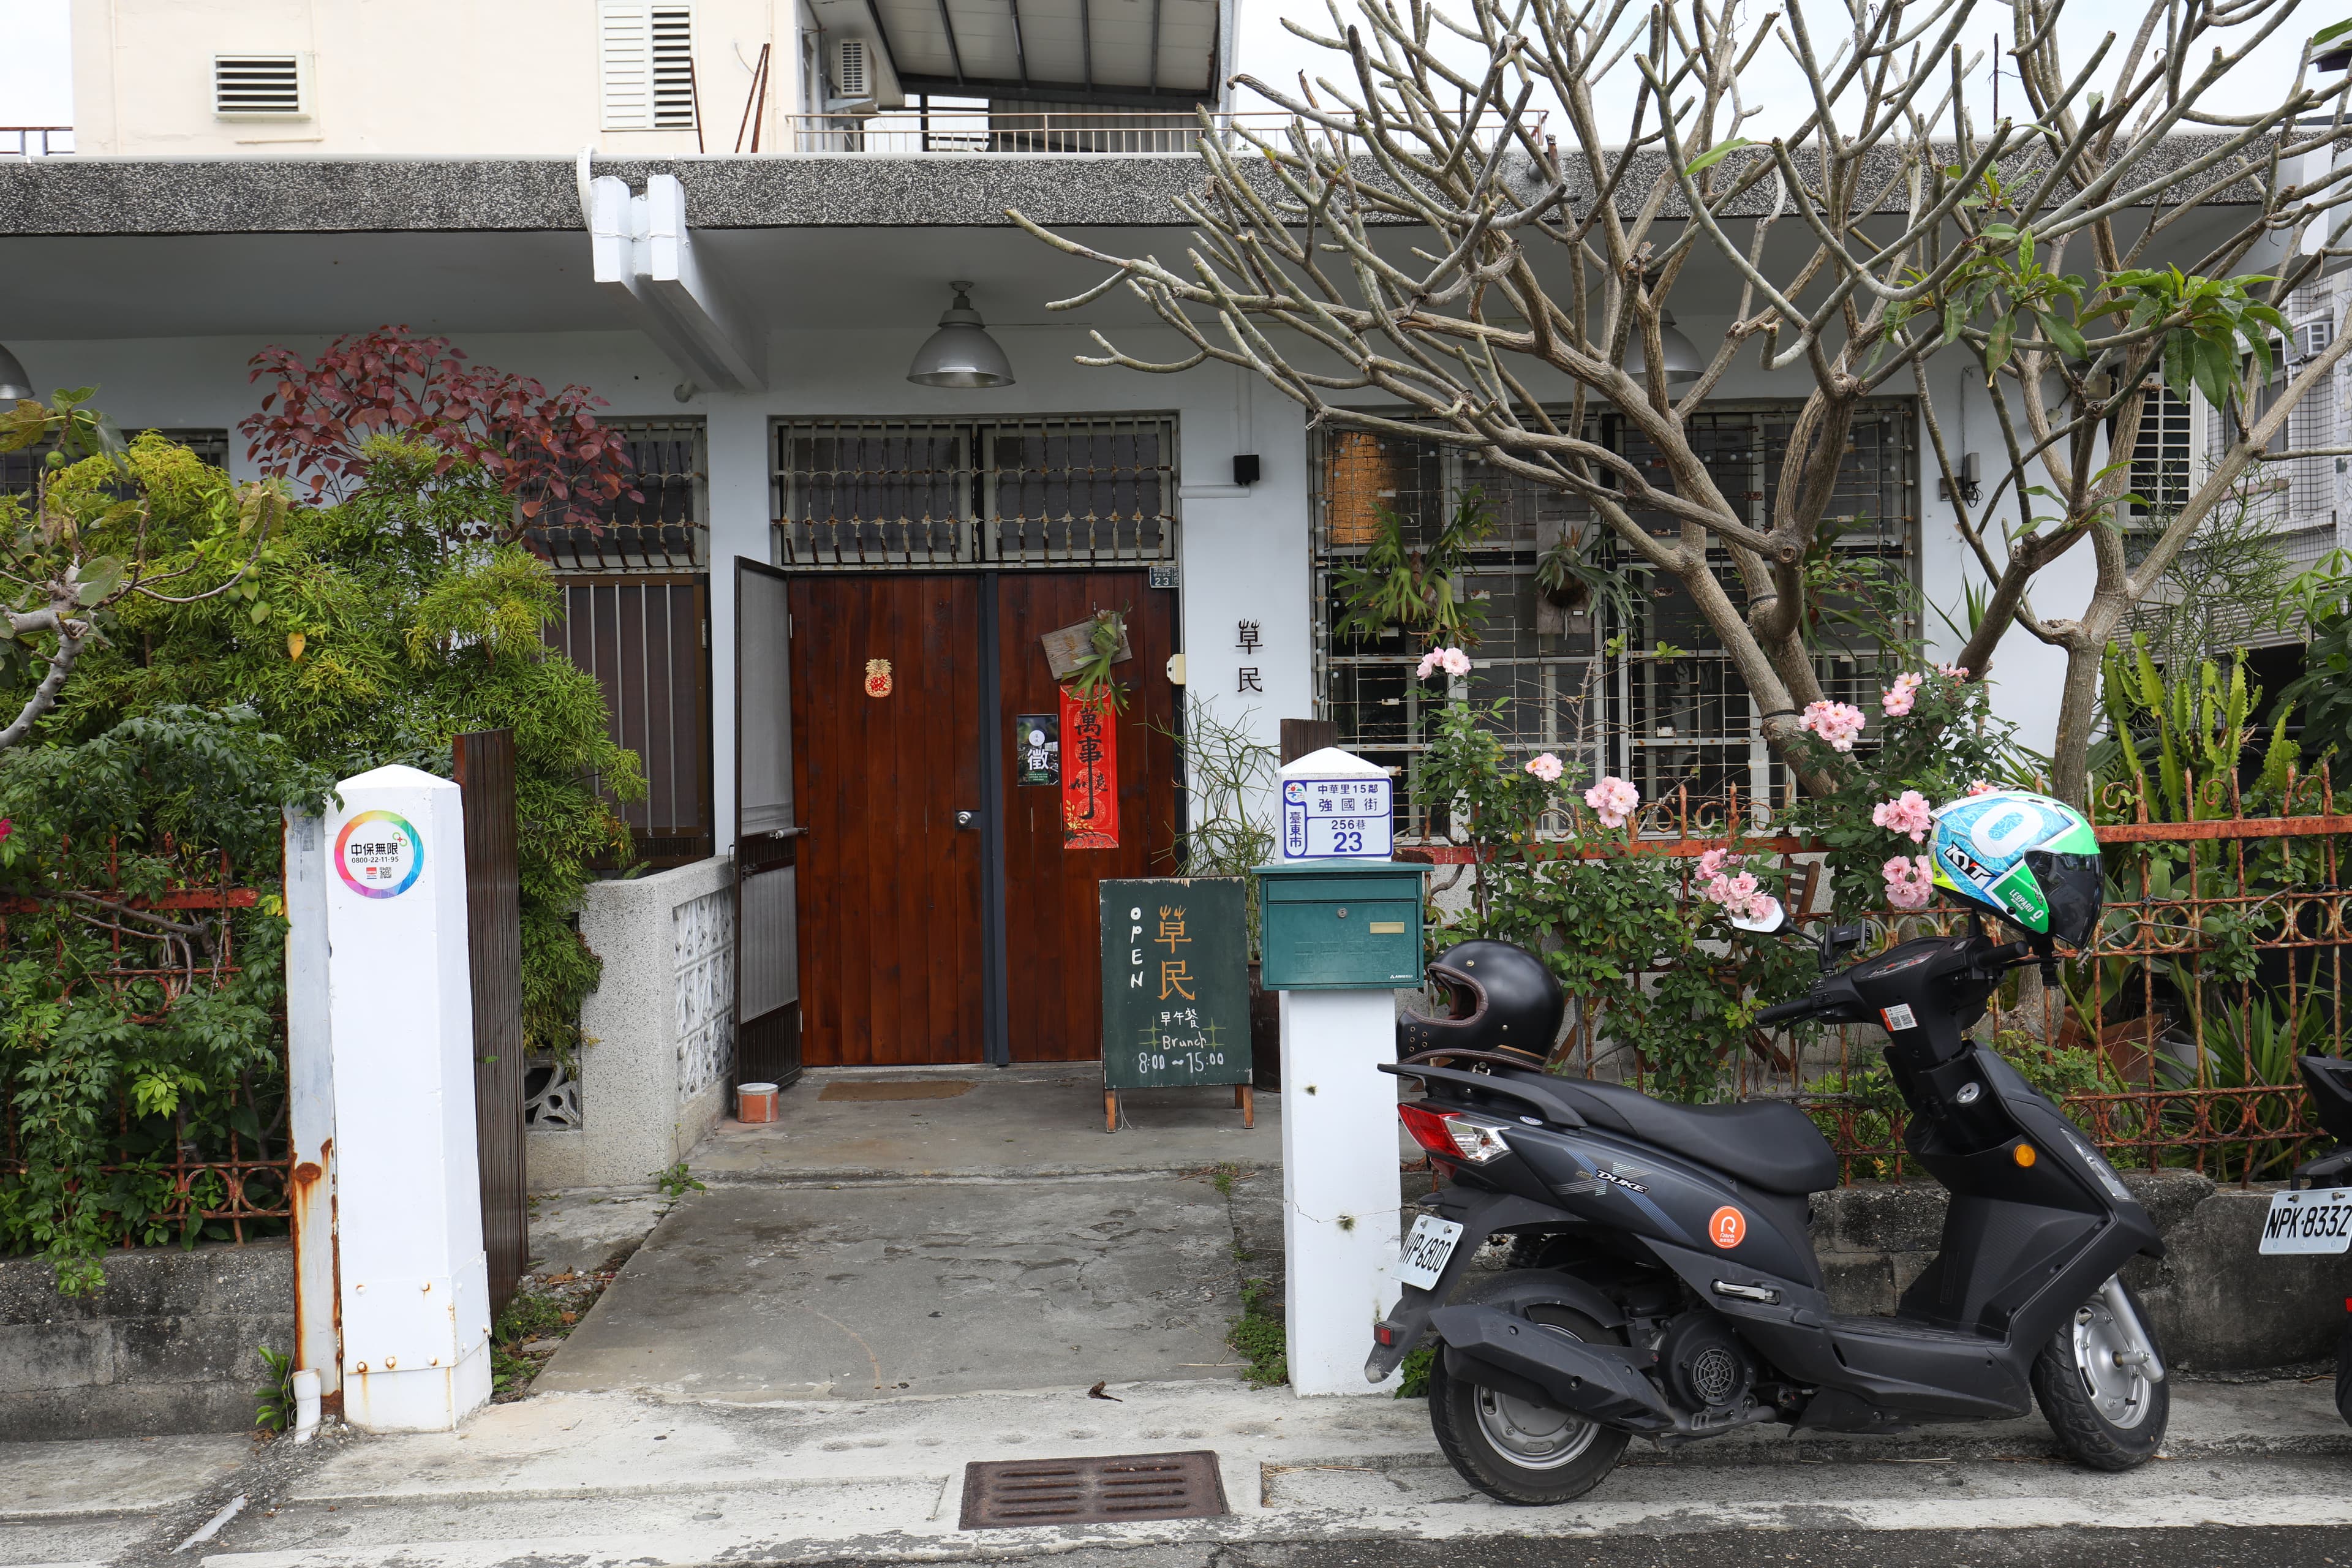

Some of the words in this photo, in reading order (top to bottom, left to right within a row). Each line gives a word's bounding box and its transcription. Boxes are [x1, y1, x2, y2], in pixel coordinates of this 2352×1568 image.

[1155, 577, 1169, 586] 23
[1235, 617, 1264, 693] 草民
[1027, 748, 1049, 771] 徵
[1317, 783, 1379, 795] 中華里15鄰
[1318, 797, 1378, 812] 強國街
[1289, 811, 1303, 848] 臺東市
[1331, 819, 1366, 831] 256巷
[351, 842, 398, 856] 中保無限
[1333, 831, 1363, 853] 23
[1944, 842, 1994, 881] KYT
[1153, 904, 1196, 1001] 草民
[1160, 1007, 1200, 1030] 早午餐
[1162, 1030, 1207, 1050] Brunch
[1597, 1169, 1649, 1193] DUKE
[2264, 1204, 2352, 1240] NPK-8332
